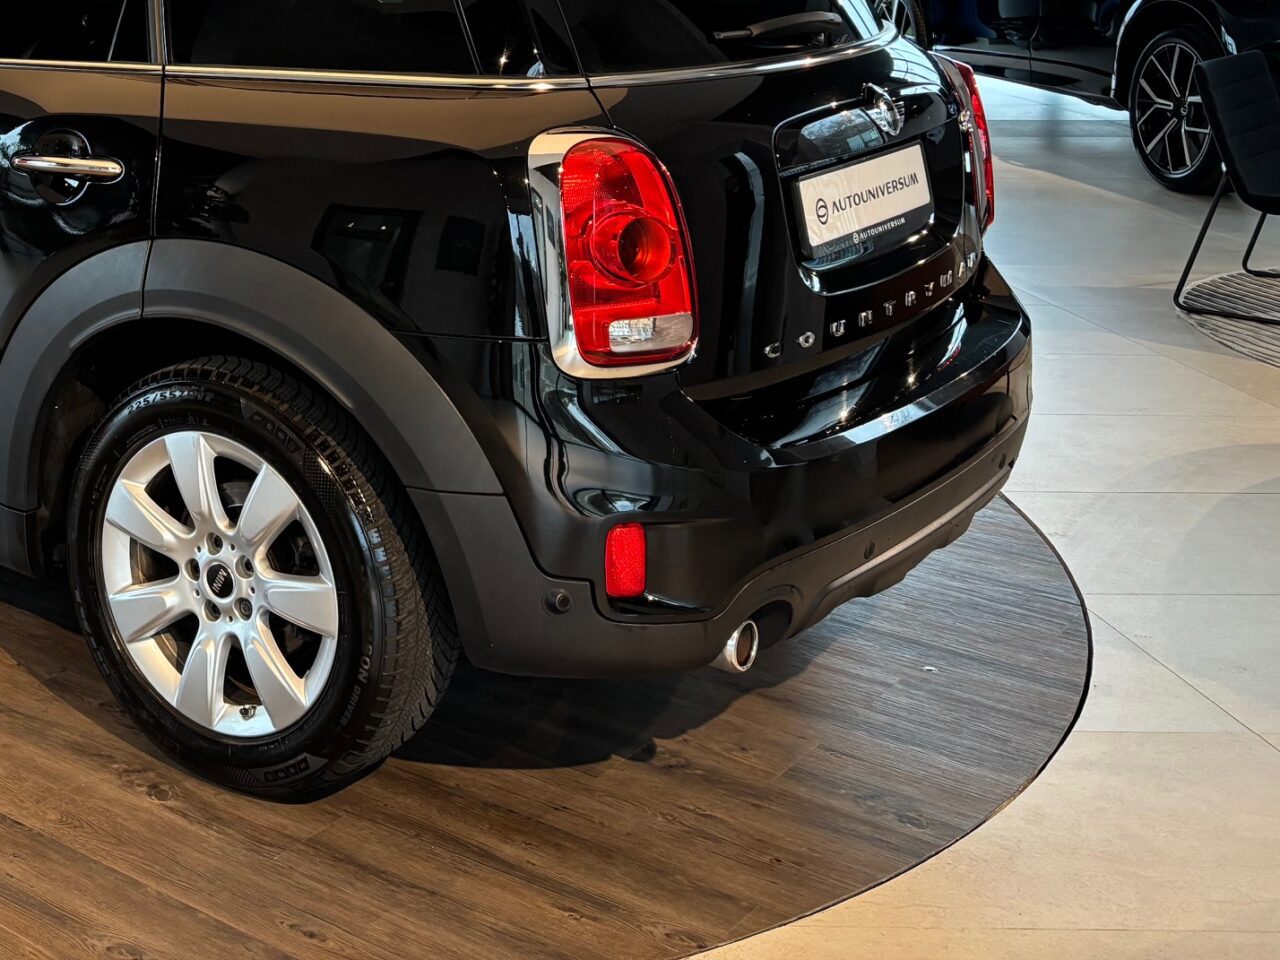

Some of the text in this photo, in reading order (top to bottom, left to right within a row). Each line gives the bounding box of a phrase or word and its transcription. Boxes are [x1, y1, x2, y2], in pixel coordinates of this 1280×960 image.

[831, 172, 919, 215] AUTOUNIVERSUM
[859, 217, 906, 240] AUTOUNIVERSUM
[211, 568, 228, 593] MINI
